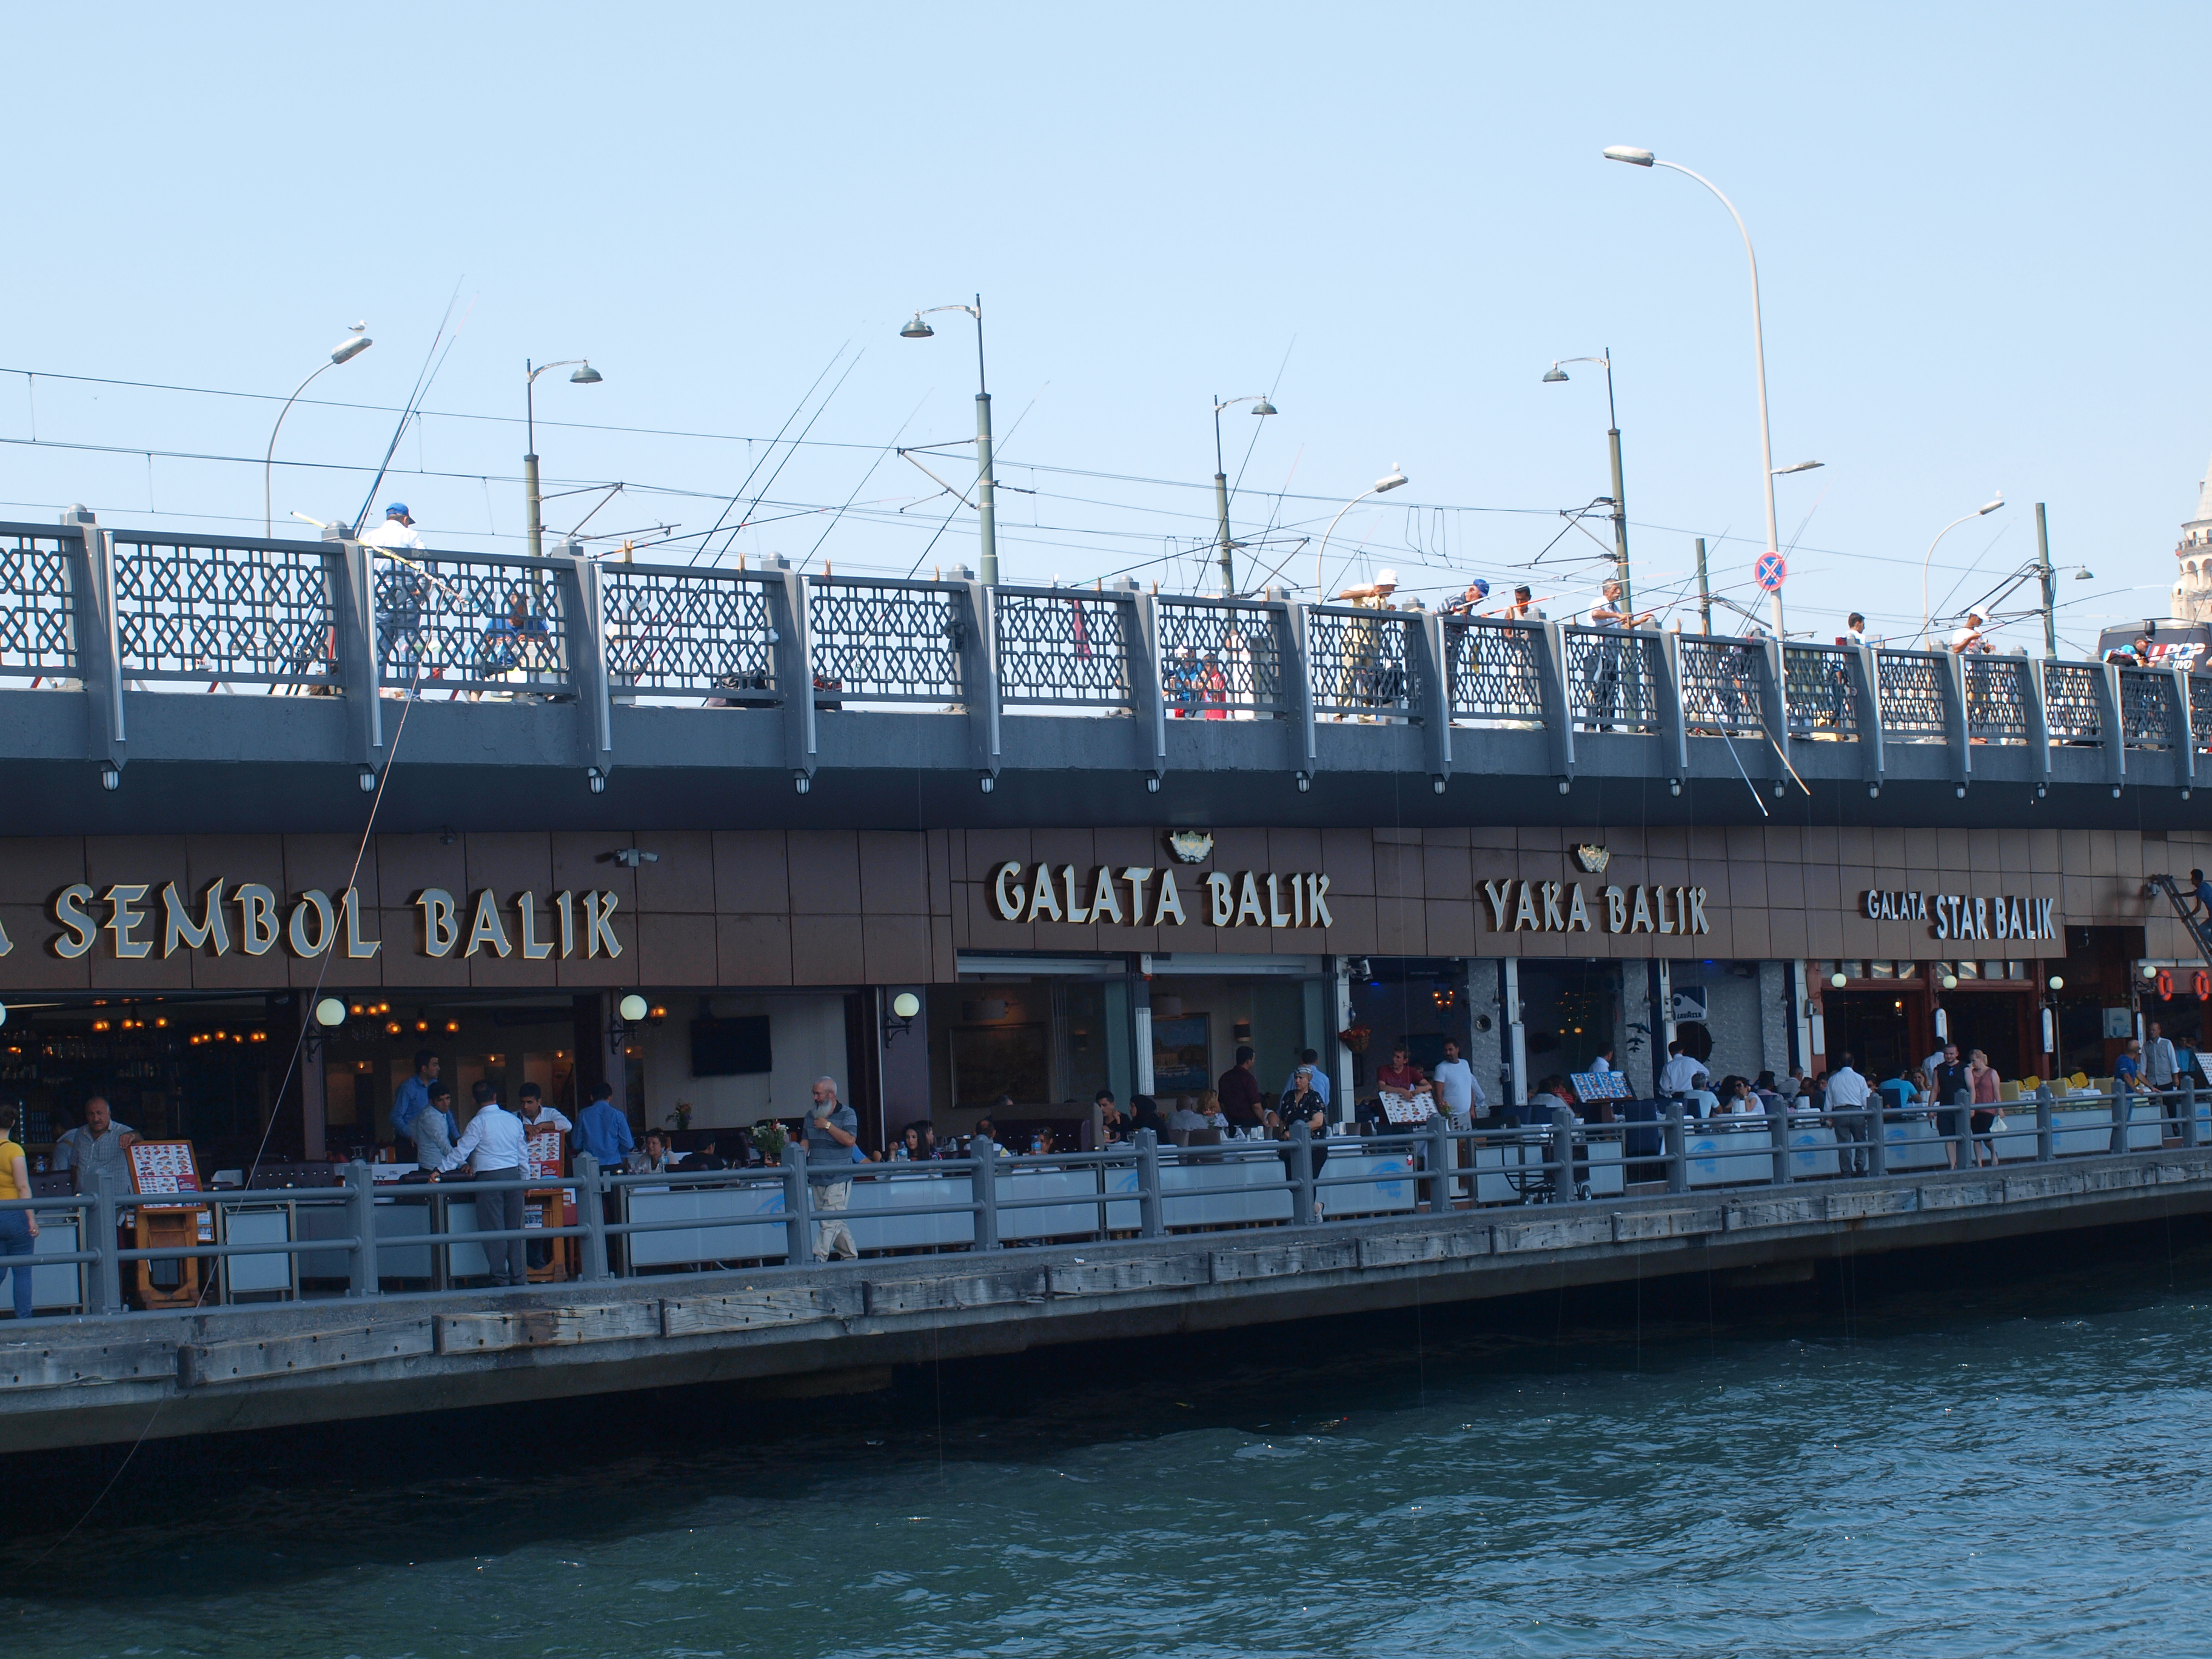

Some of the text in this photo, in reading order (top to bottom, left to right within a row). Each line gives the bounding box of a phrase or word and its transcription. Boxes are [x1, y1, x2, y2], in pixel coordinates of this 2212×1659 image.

[2163, 643, 2206, 660] POP
[55, 877, 381, 959] SEMBOL
[416, 888, 623, 959] BALIK
[996, 861, 1333, 928] GALATA BALIK
[1485, 879, 1710, 934] YAKA BALIK
[1868, 890, 2056, 940] GALATA STAR BALIK
[1677, 1011, 1702, 1019] LAVAZZA
